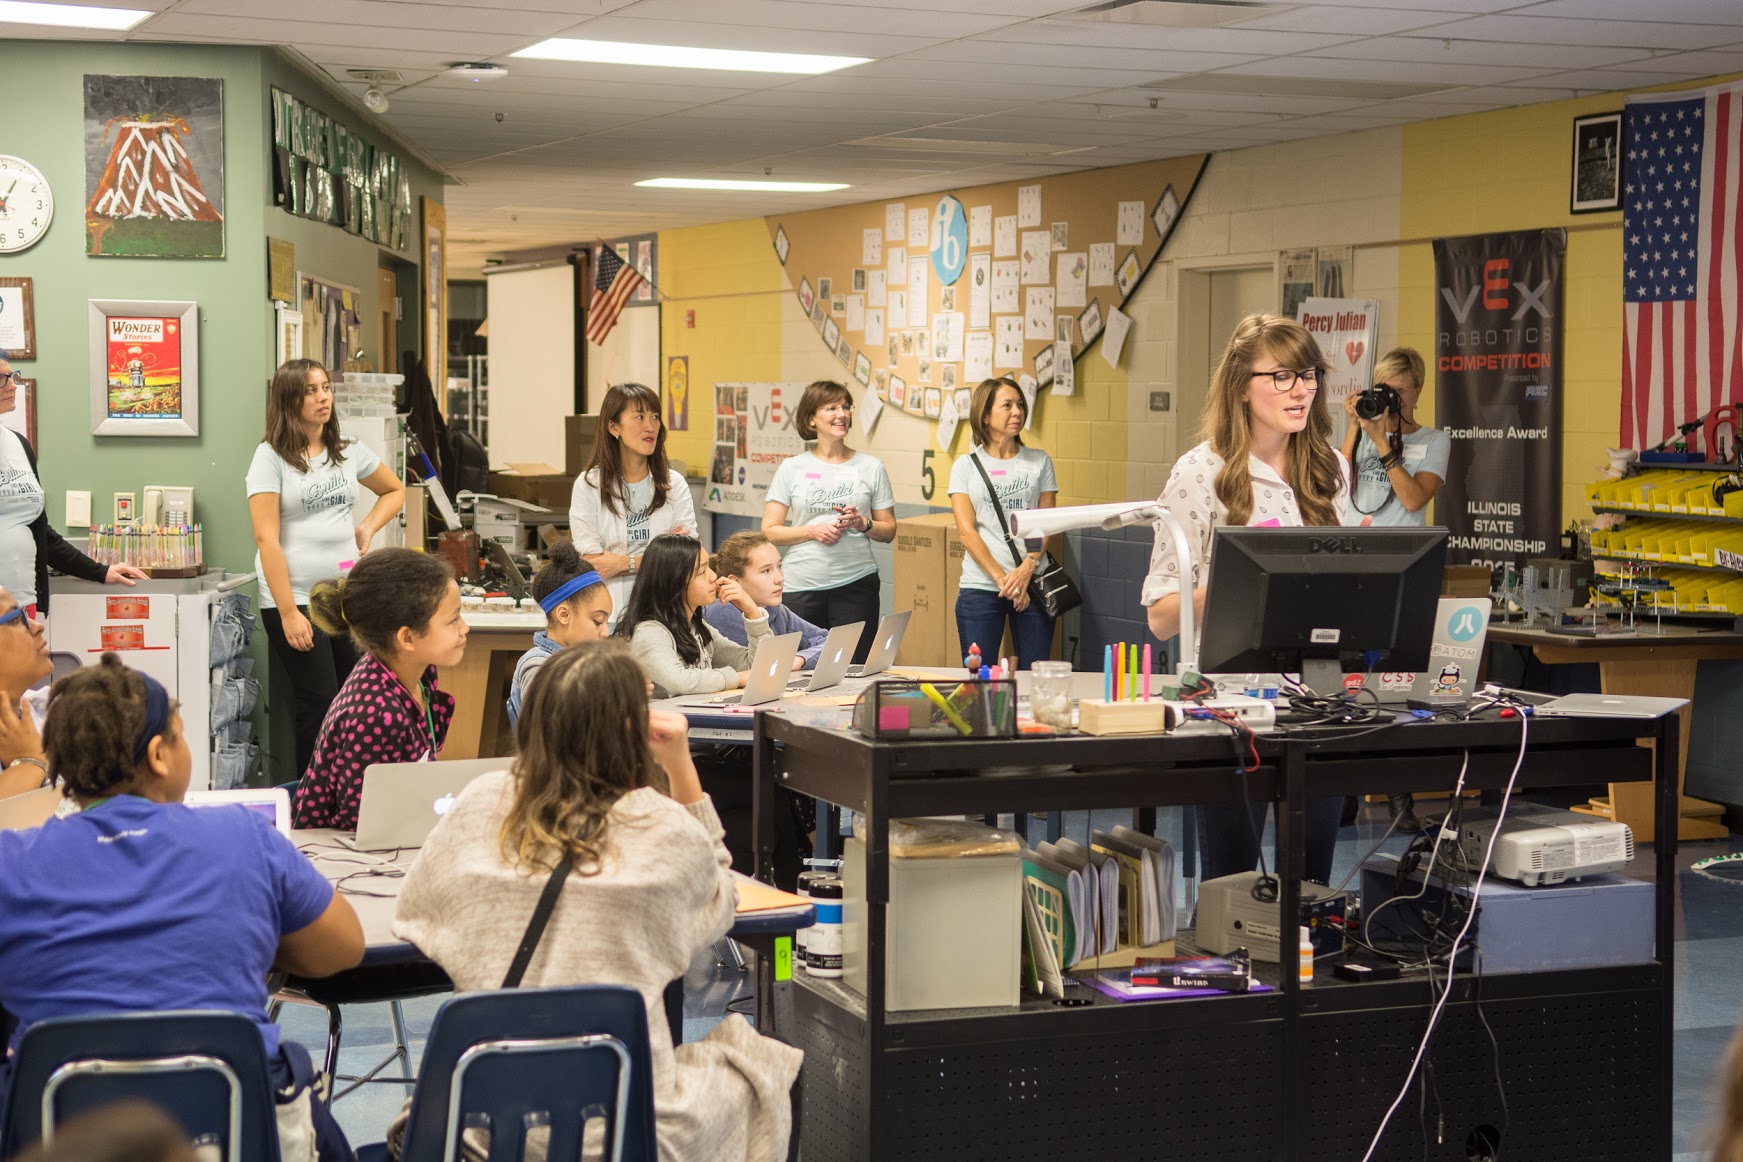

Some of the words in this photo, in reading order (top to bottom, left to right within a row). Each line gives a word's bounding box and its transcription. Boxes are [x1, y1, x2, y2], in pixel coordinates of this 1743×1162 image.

[36, 199, 43, 210] 3
[31, 217, 38, 227] 4
[18, 228, 25, 239] 5
[1440, 258, 1552, 324] VEX
[112, 321, 161, 335] WONDER
[1303, 312, 1333, 333] Percy
[1334, 311, 1367, 331] Julian
[1440, 327, 1552, 346] ROBOTICS
[1439, 352, 1551, 371] COMPETITION
[1444, 426, 1503, 438] Excellence
[1507, 426, 1548, 438] Award
[921, 449, 935, 500] 5
[306, 470, 348, 504] Build
[810, 482, 855, 506] Build
[330, 494, 347, 506] GIRL
[1008, 498, 1024, 509] GIRL
[1467, 501, 1521, 516] ILLINOIS
[1474, 519, 1514, 533] STATE
[1308, 536, 1363, 554] DELL
[1443, 647, 1477, 658] ATOM
[1381, 672, 1414, 683] CSS
